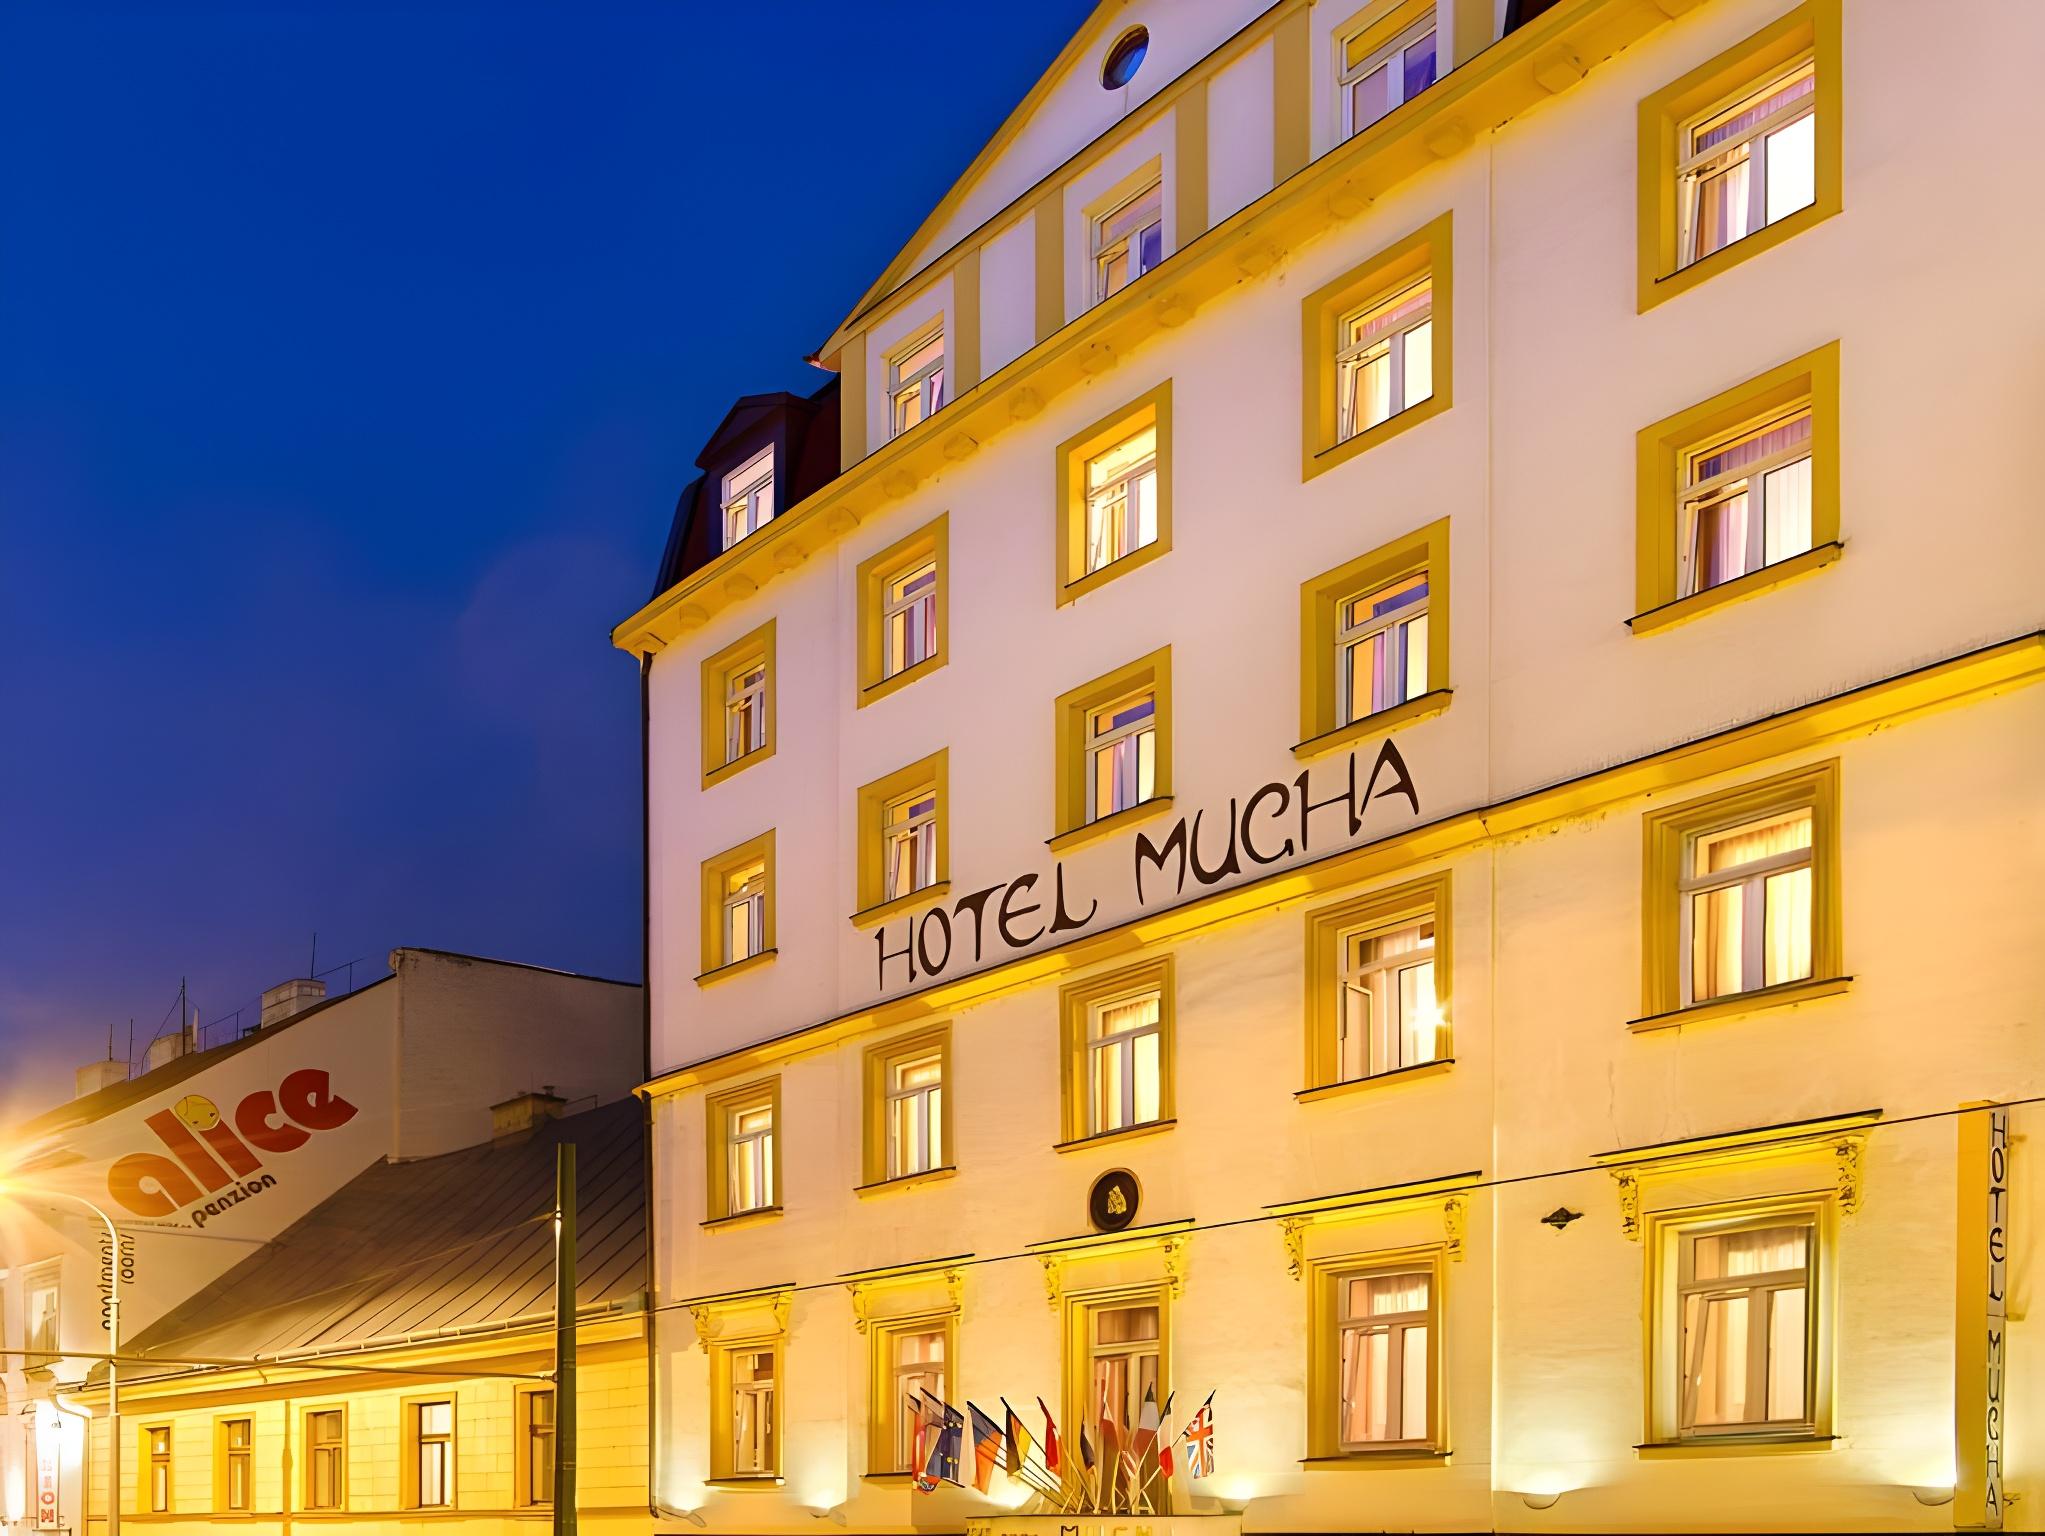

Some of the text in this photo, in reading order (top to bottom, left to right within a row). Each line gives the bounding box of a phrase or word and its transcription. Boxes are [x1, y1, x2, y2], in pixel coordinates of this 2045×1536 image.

[875, 738, 1419, 991] HOTEL MUCHA
[107, 1068, 359, 1217] alice
[191, 1174, 277, 1229] penzion
[1985, 1111, 2007, 1517] HOTEL MUCHA
